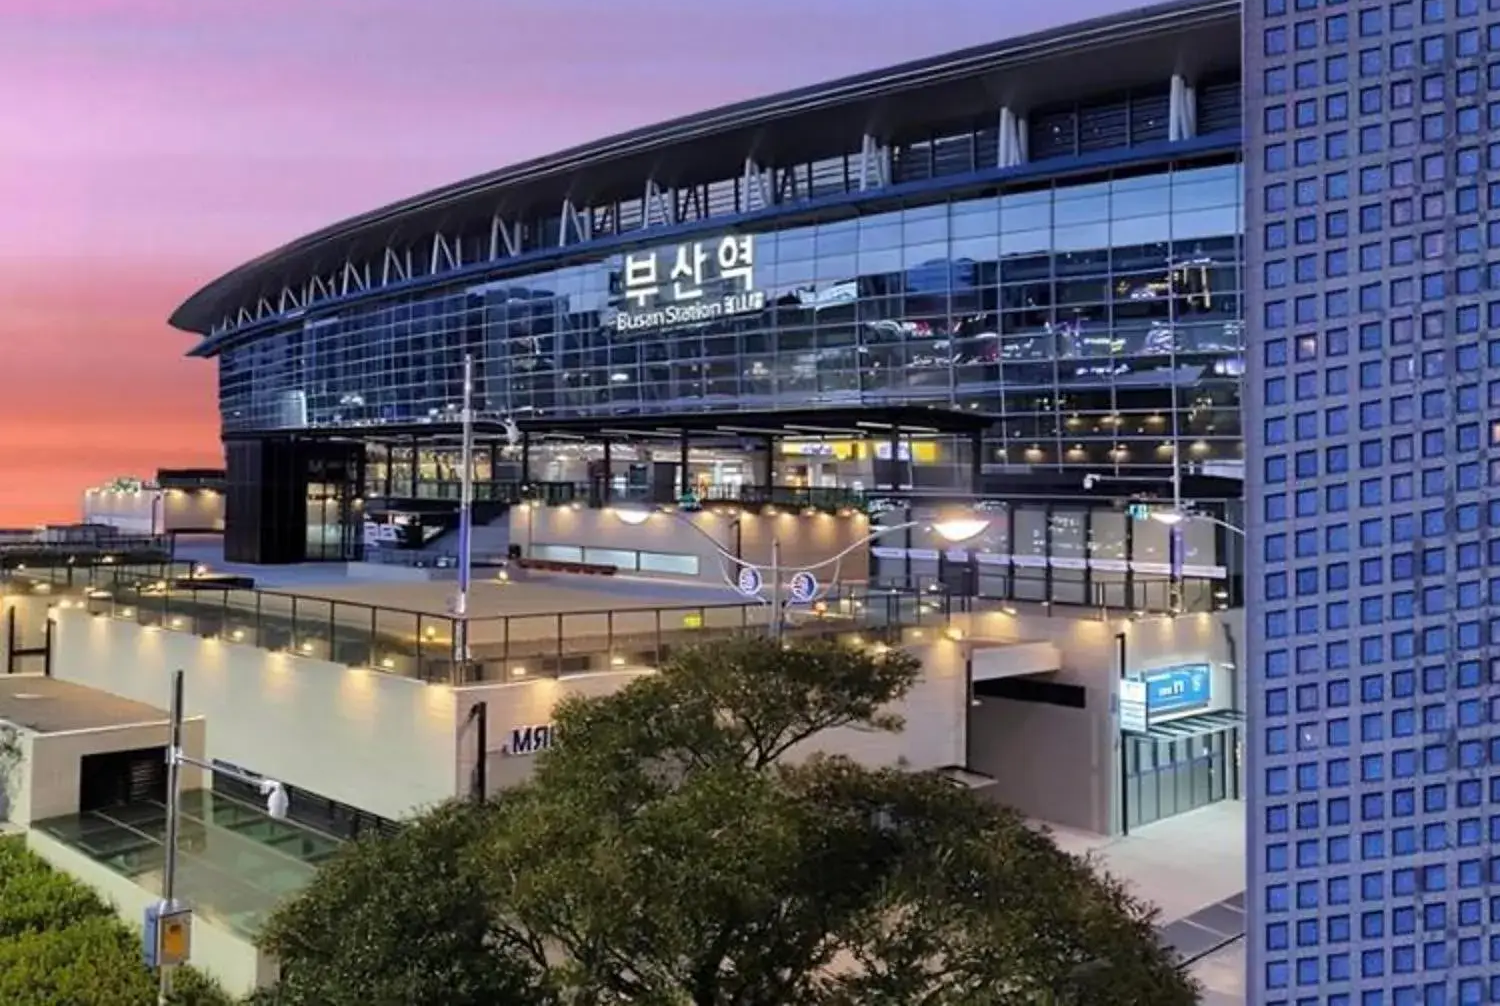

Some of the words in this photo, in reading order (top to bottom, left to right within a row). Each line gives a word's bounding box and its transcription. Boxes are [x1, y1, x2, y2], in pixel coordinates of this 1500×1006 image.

[625, 234, 753, 307] 부산역
[616, 311, 664, 331] Busan
[664, 301, 721, 324] Station
